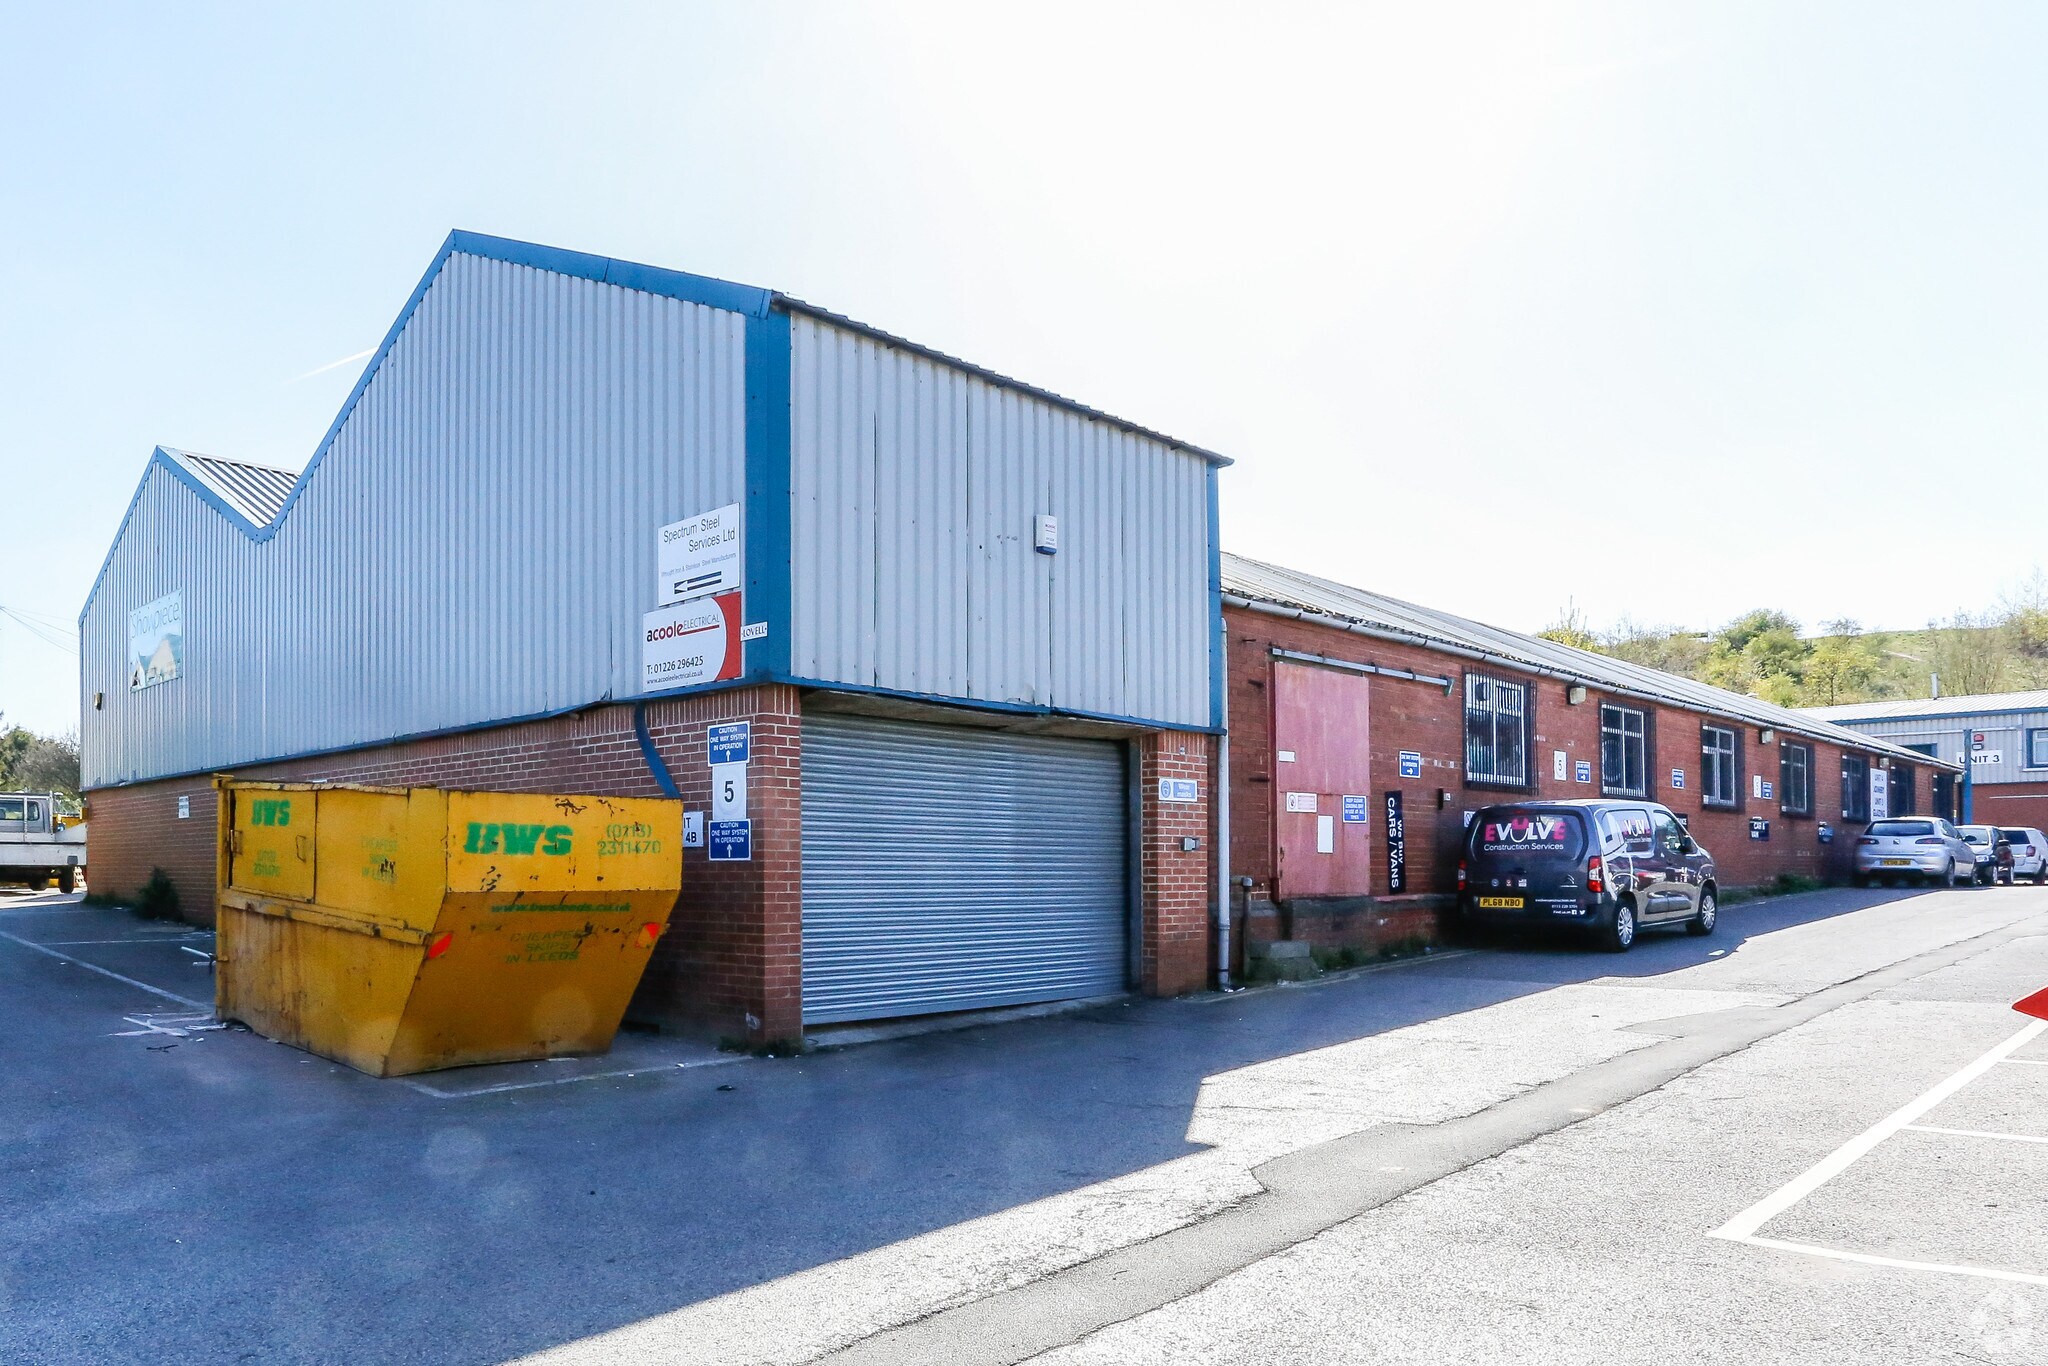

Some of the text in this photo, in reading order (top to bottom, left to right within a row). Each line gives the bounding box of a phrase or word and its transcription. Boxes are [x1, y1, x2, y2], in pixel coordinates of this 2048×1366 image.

[663, 514, 720, 544] Spectrum Steel
[688, 526, 736, 553] Services Ltd
[743, 626, 765, 638] LOVELL
[647, 656, 704, 675] T: 01226 296425
[718, 726, 738, 734] CAUTION
[730, 733, 747, 741] SYSTEM
[719, 742, 743, 751] OPERATION
[1993, 754, 2000, 762] 3
[724, 780, 735, 803] 5
[683, 817, 691, 829] IT
[1387, 797, 1397, 838] CARS
[1397, 820, 1403, 837] We
[1485, 817, 1566, 843] EVOLVE
[463, 822, 574, 856] BWS
[685, 831, 697, 843] 4B
[720, 836, 745, 844] OPERATION
[1531, 842, 1564, 850] Services
[1390, 849, 1399, 888] VANS
[1482, 898, 1502, 907] PL68
